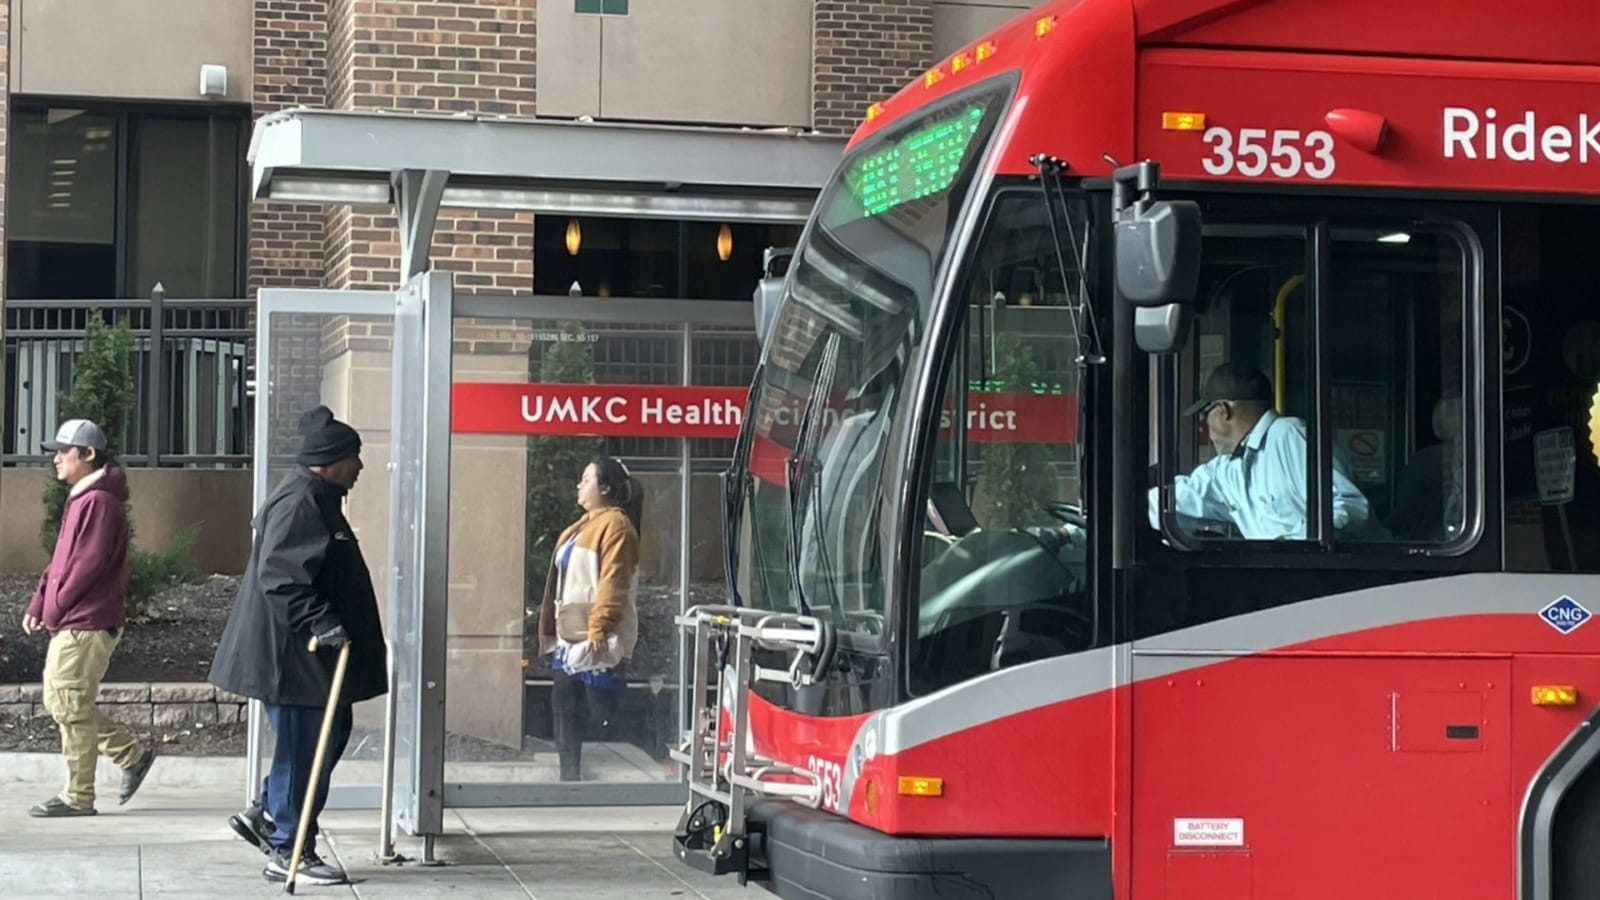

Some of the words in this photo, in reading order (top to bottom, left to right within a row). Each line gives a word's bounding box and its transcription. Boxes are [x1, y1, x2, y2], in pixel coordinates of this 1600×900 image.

[1202, 126, 1336, 179] 3553
[521, 395, 628, 423] UMKC
[640, 397, 742, 425] Health
[1547, 607, 1582, 621] CNG
[1188, 822, 1229, 831] BATTERY
[1179, 832, 1238, 840] DISCONNECT
